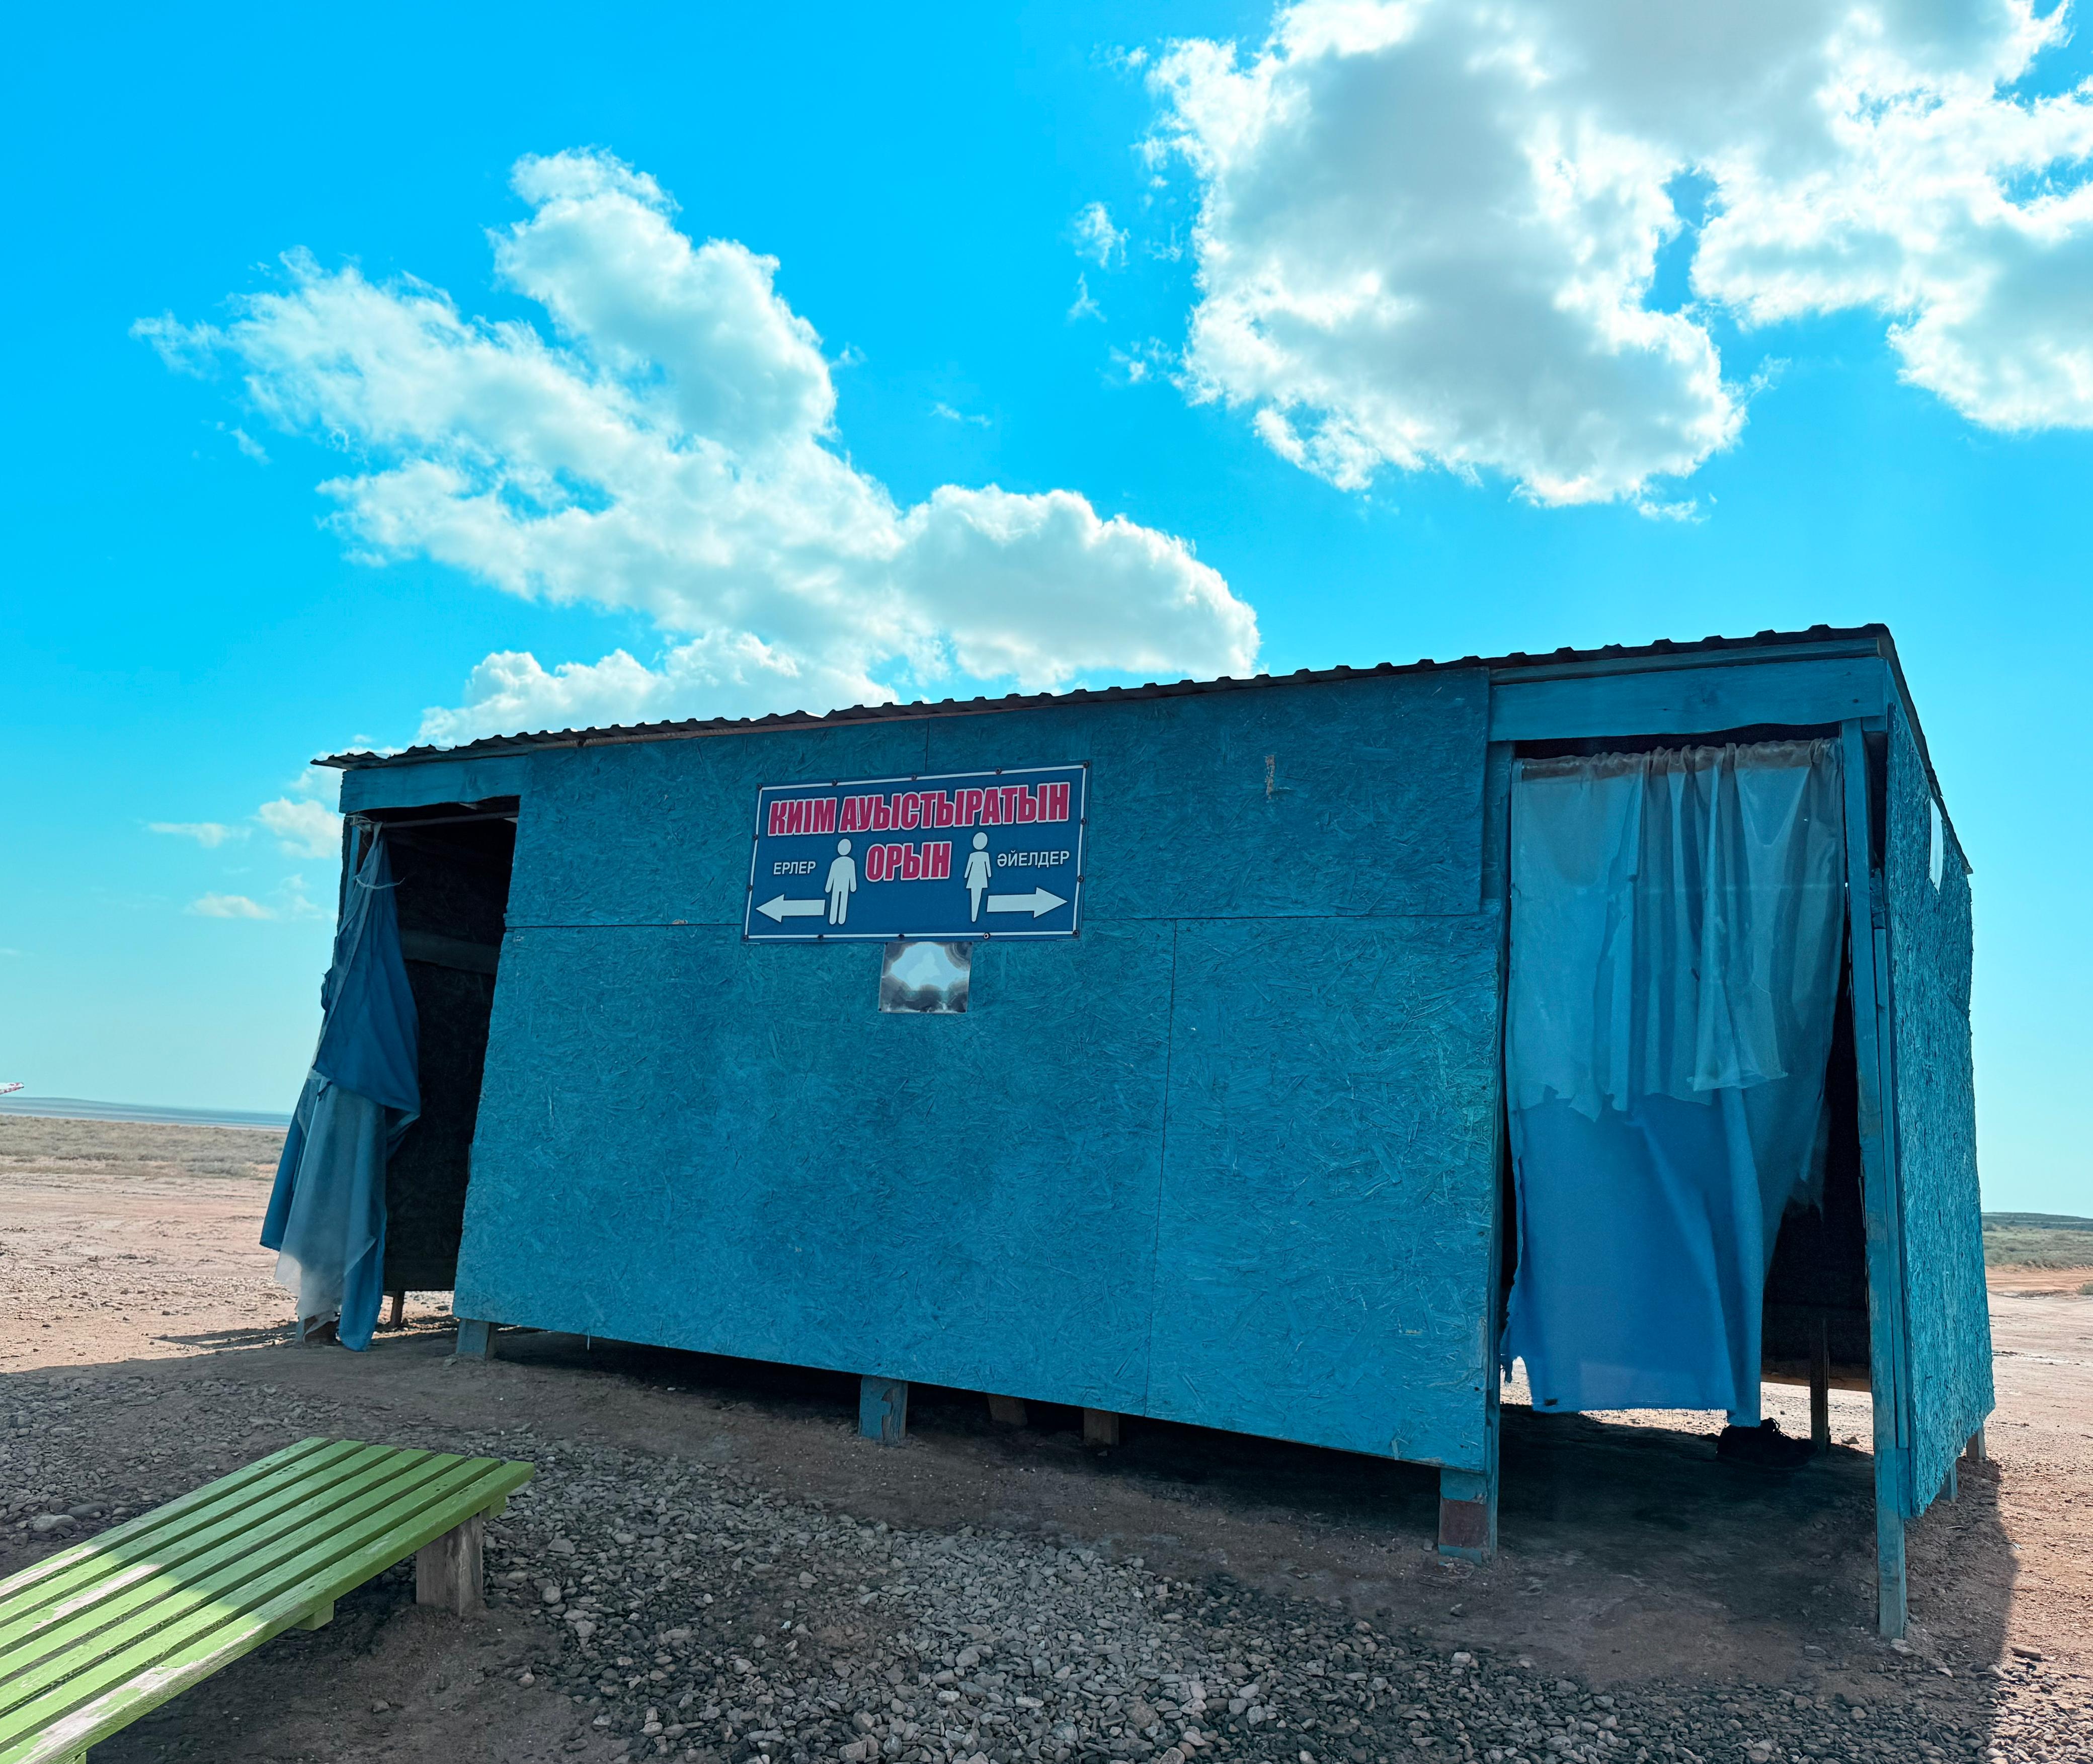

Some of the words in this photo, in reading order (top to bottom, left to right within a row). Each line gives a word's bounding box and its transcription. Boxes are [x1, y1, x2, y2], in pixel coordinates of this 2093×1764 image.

[768, 797, 837, 836] КИІМ
[838, 782, 1070, 833] АУЫСТЫРАТЫН
[773, 861, 816, 874] ЕРЛЕР
[865, 841, 952, 882] ОРЫН
[997, 850, 1070, 868] ӘЙЕЛДЕР
